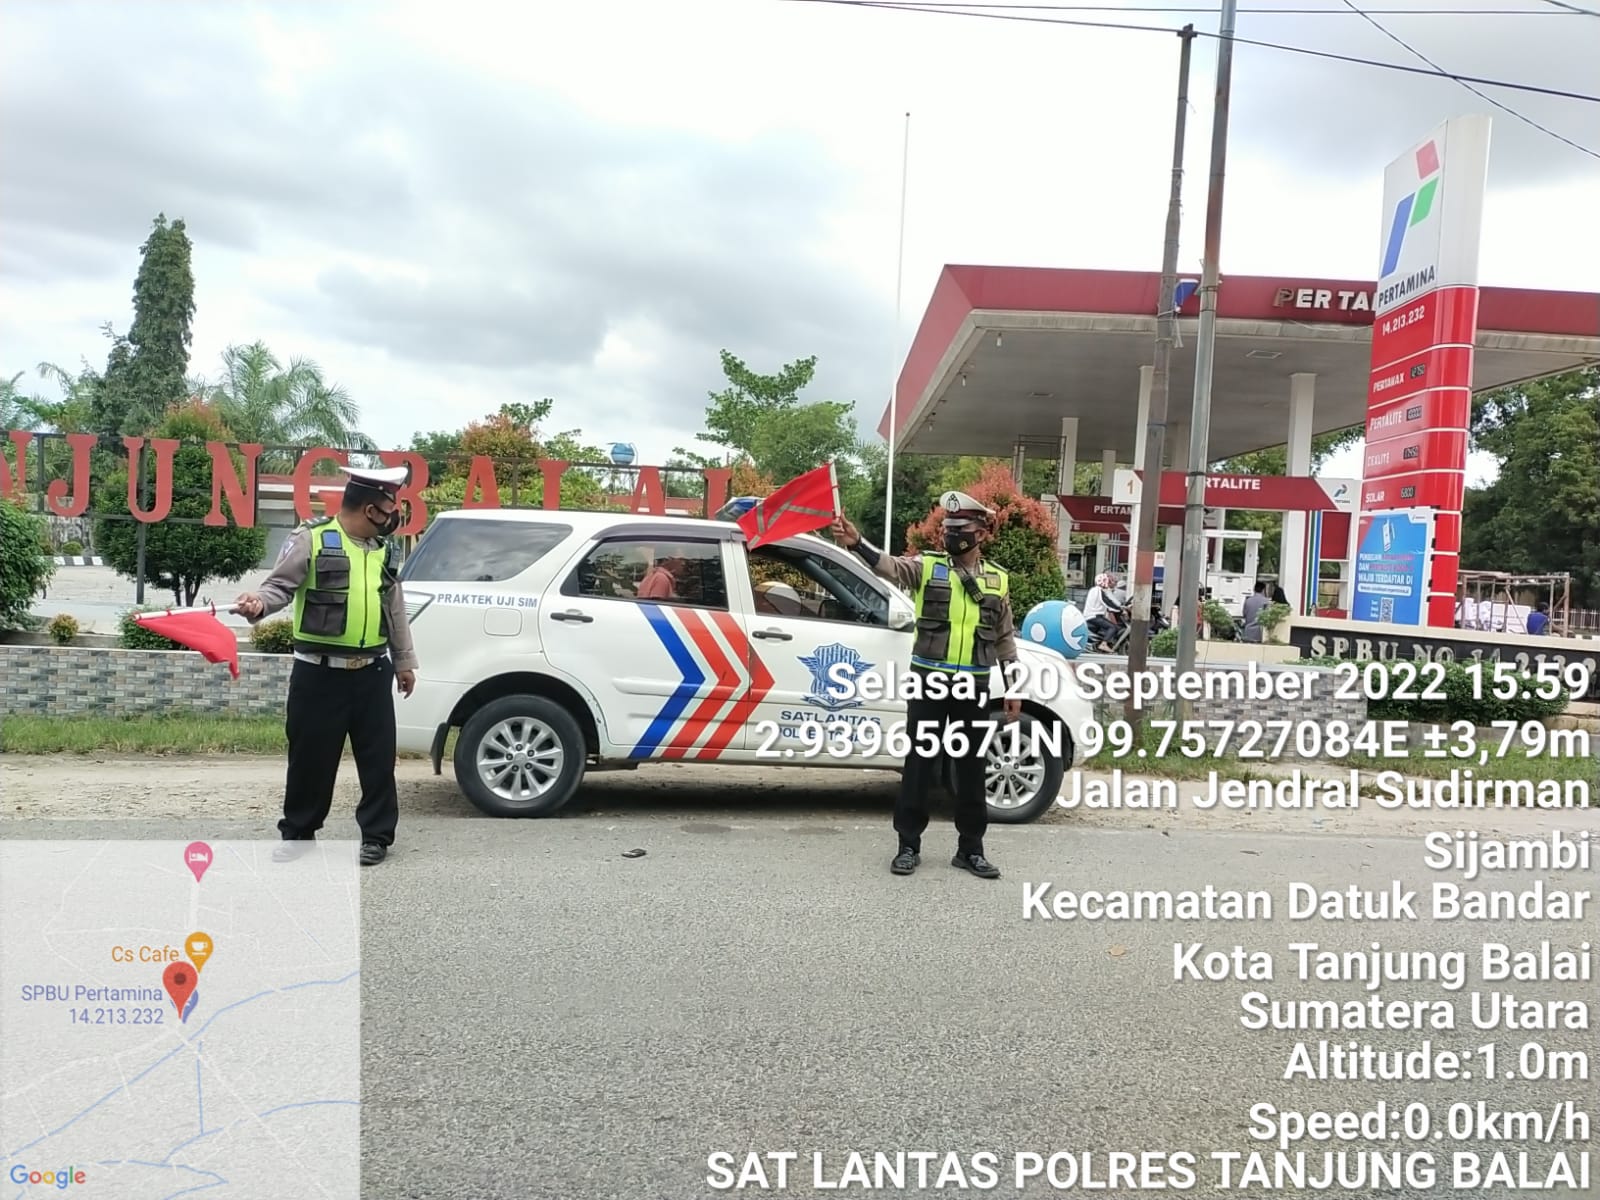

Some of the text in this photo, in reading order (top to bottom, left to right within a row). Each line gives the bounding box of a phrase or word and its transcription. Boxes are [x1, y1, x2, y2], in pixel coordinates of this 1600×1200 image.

[1377, 264, 1436, 308] PERTAMINA
[1382, 304, 1426, 337] 14.213.232
[1370, 410, 1402, 432] PERTALITE
[1127, 479, 1134, 495] 1
[1366, 487, 1414, 503] SOLAR 6800
[437, 593, 538, 608] PRAKTEK UJI SIM
[1310, 634, 1399, 661] SPBU
